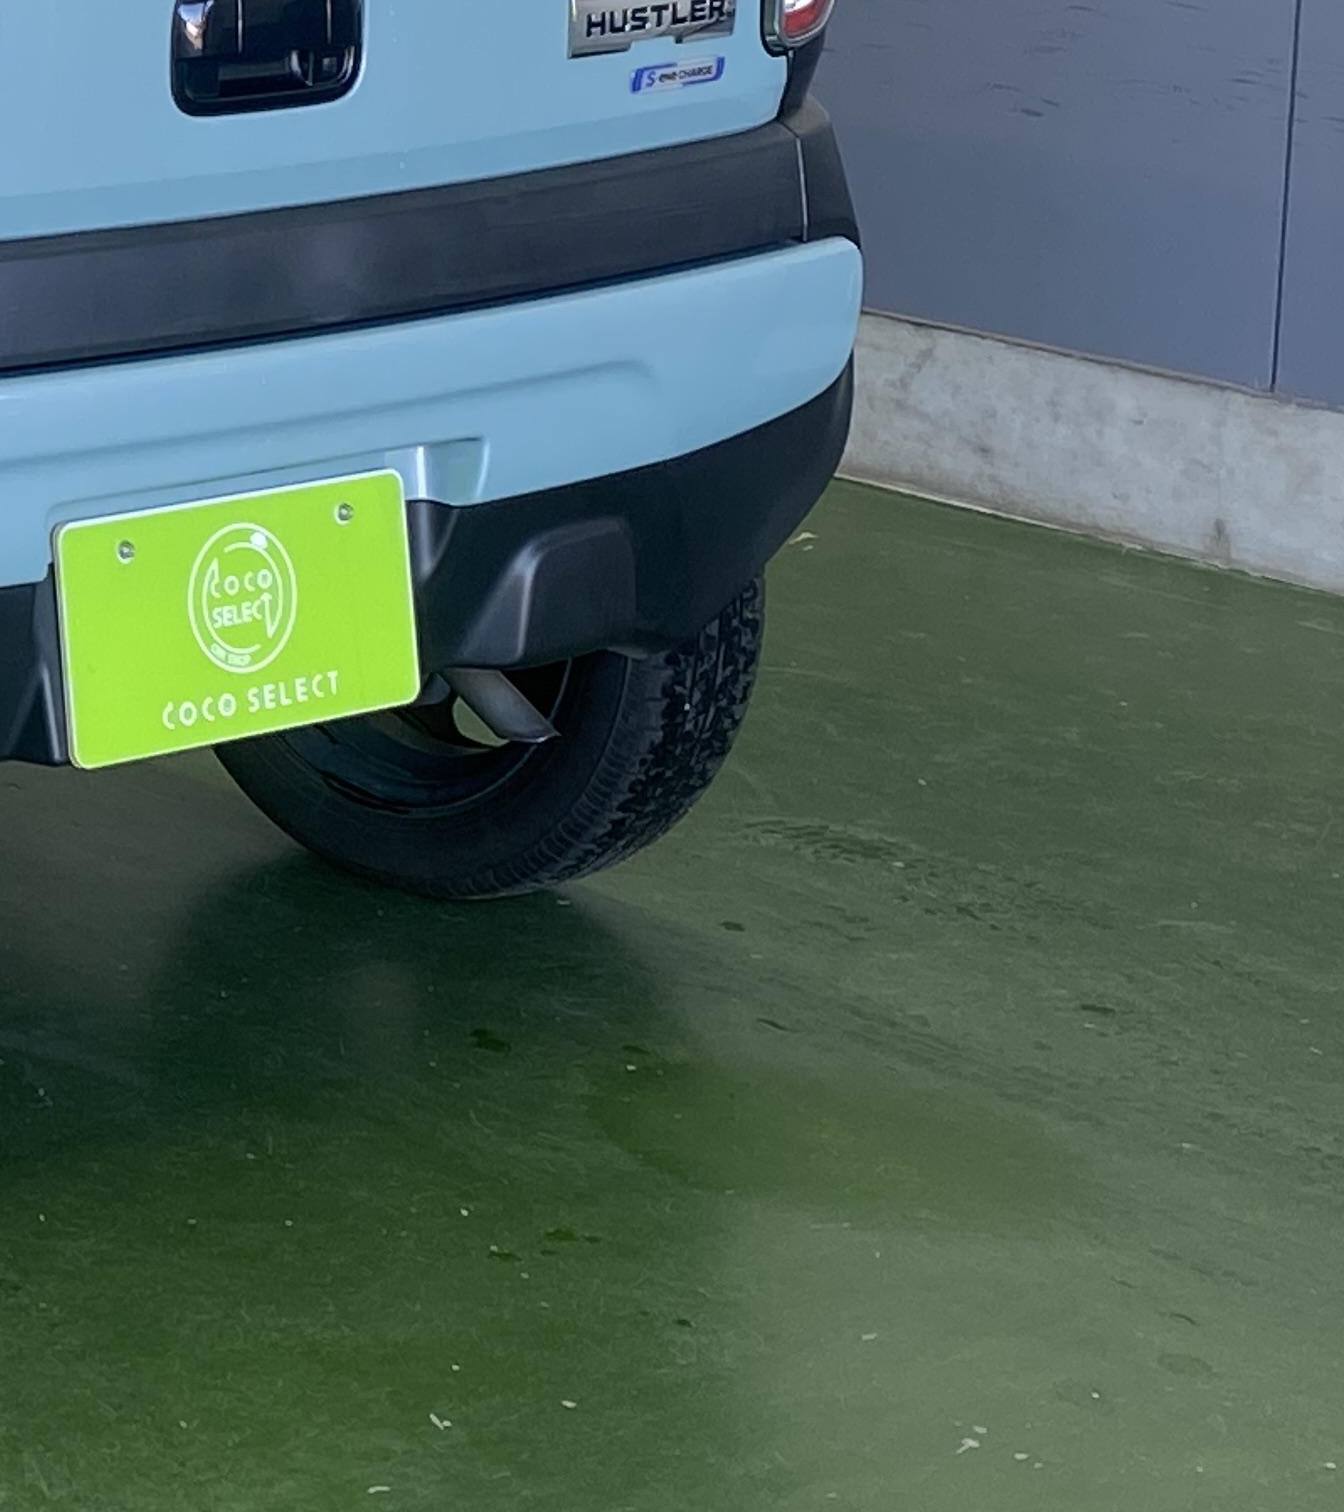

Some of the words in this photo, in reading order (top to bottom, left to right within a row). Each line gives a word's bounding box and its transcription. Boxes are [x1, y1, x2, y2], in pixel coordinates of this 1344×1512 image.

[210, 561, 272, 598] COCO
[212, 592, 273, 635] SELECT
[162, 693, 236, 729] COCO
[248, 671, 338, 712] SELECT
